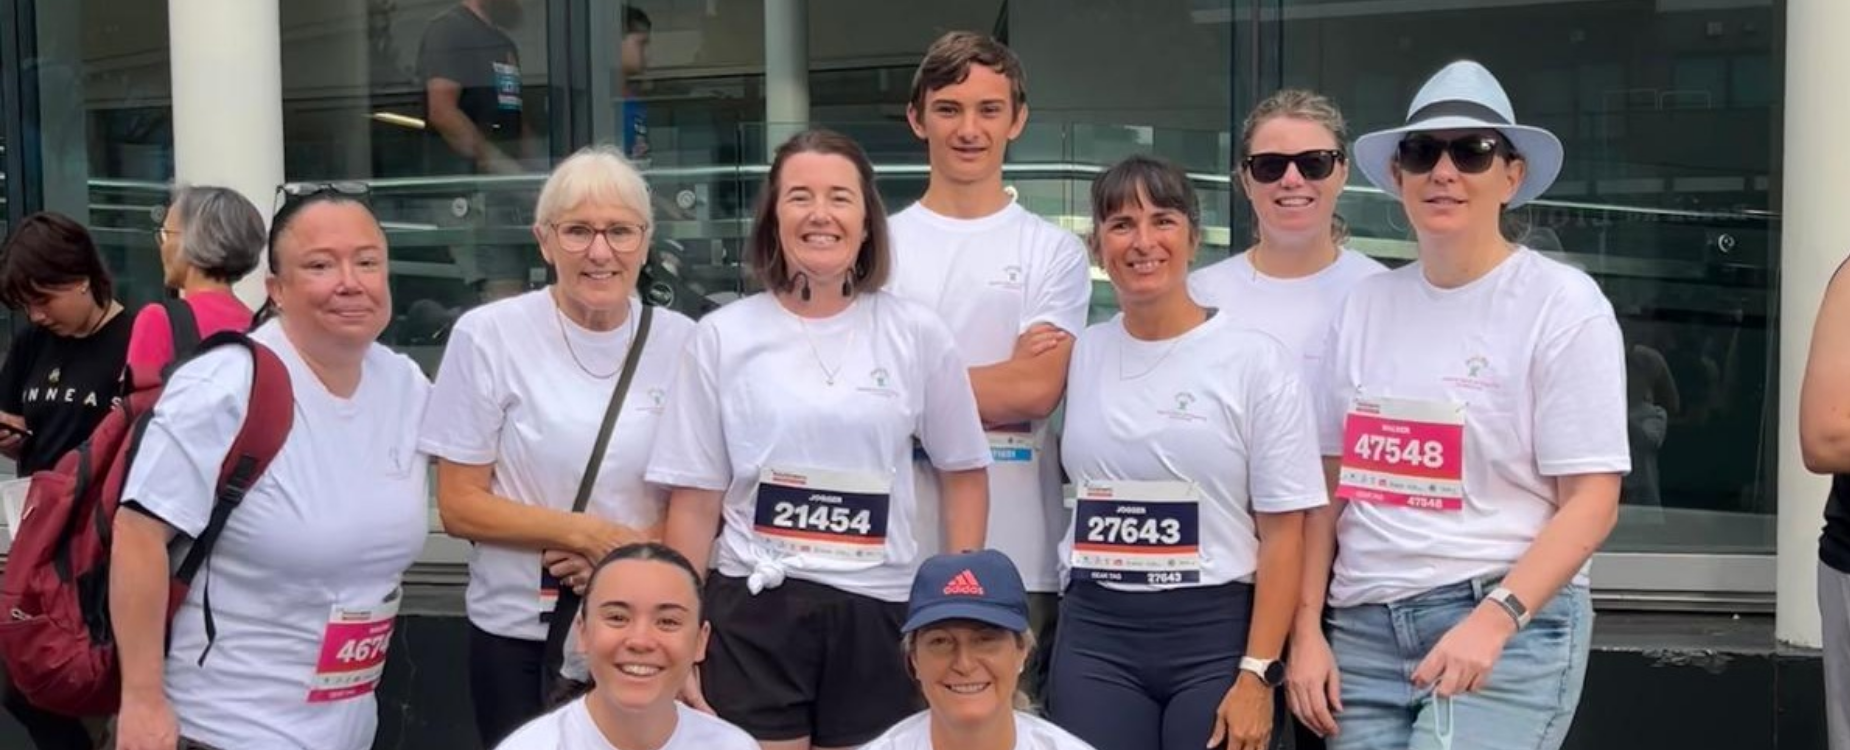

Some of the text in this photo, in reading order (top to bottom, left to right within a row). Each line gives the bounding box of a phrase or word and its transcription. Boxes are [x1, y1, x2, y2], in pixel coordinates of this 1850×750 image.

[1354, 433, 1444, 468] 47548
[772, 501, 871, 535] 21454
[1087, 516, 1181, 545] 27643
[943, 586, 984, 596] adidas
